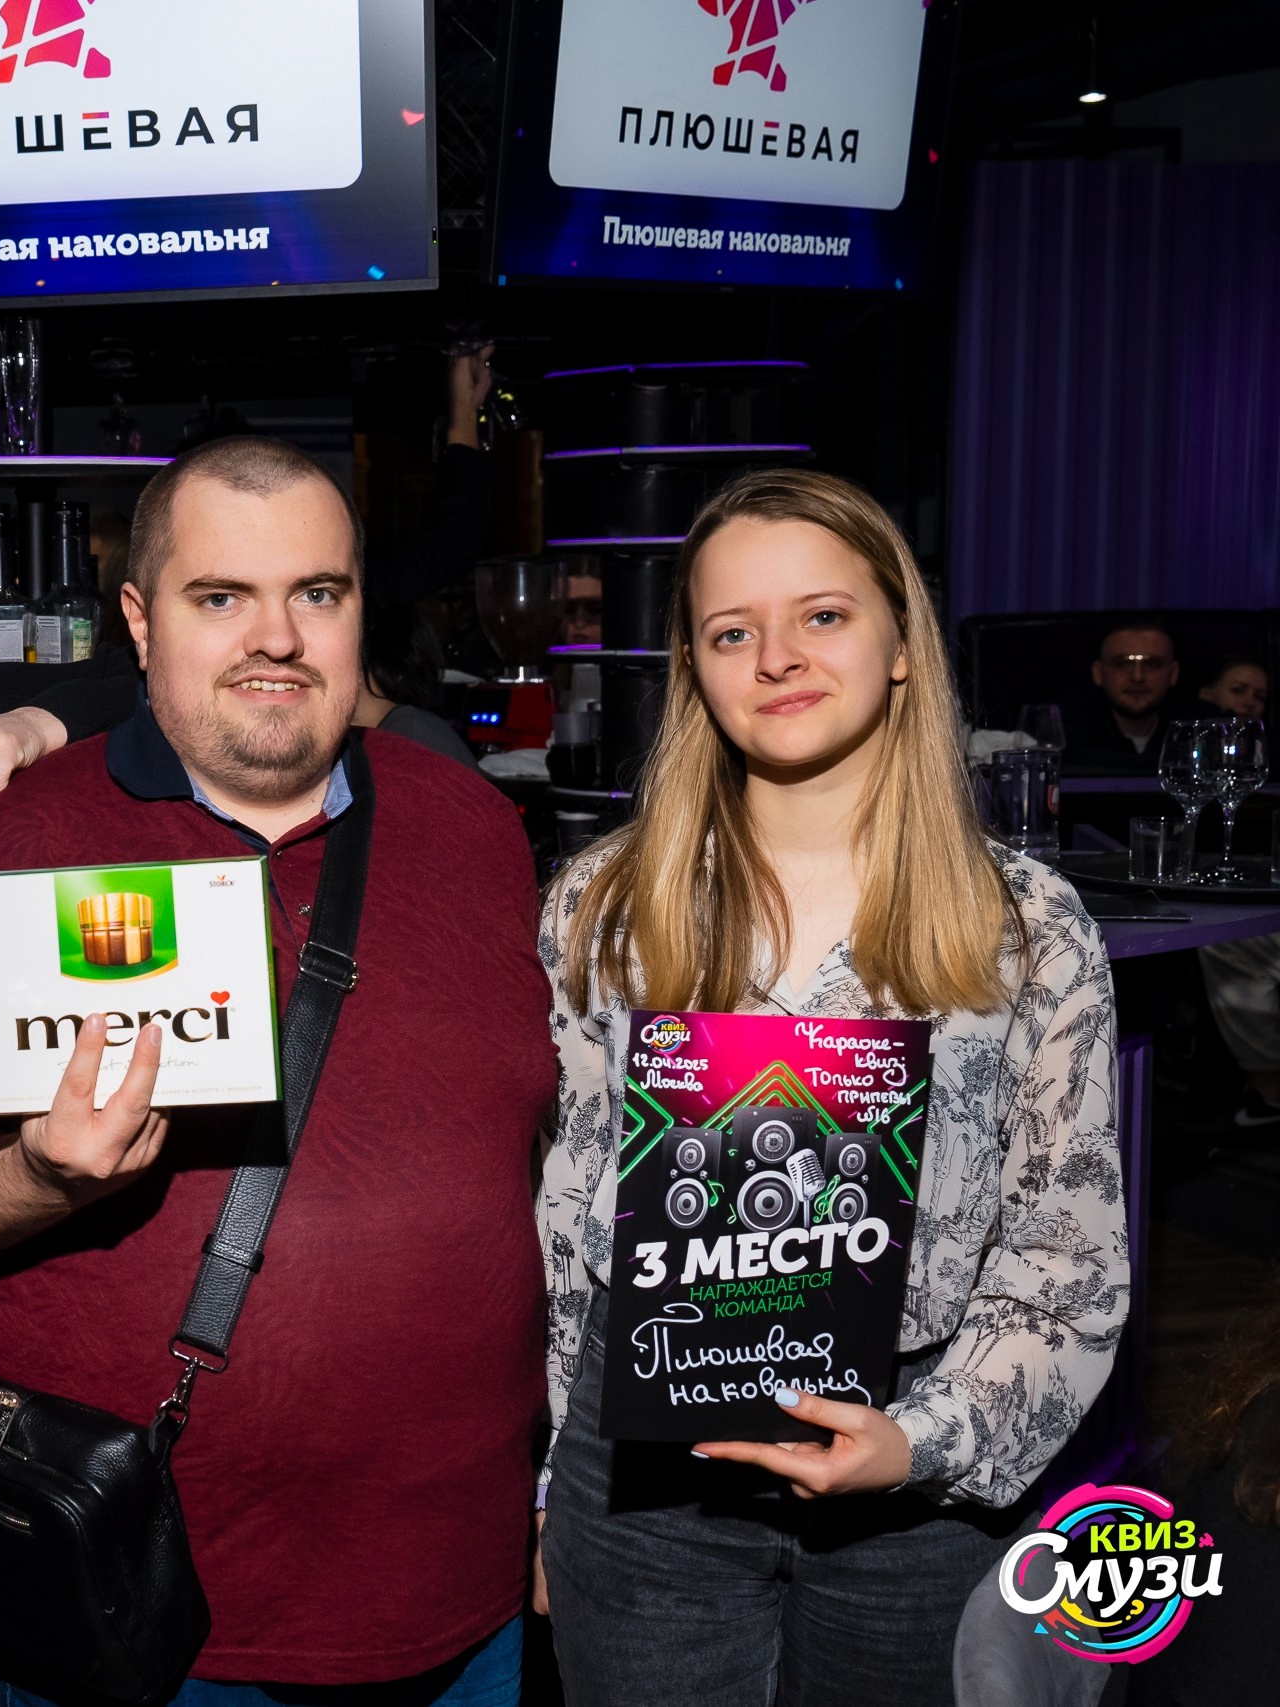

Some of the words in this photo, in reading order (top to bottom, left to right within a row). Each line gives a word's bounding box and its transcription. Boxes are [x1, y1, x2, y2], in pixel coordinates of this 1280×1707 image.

[619, 106, 859, 163] ПЛЮШЕВАЯ
[49, 227, 270, 259] наковальня
[603, 216, 723, 250] Плюшевая
[728, 230, 851, 257] наковальня
[15, 991, 231, 1051] merci
[640, 1024, 691, 1045] Смузи
[661, 1023, 686, 1031] КВИЗ
[632, 1052, 709, 1071] 12.04.2025
[803, 1067, 875, 1087] Только
[640, 1069, 704, 1092] Москва
[632, 1241, 668, 1289] 3
[680, 1217, 890, 1285] МЕСТО
[690, 1271, 833, 1302] НАГРАЖДАЕТСЯ
[715, 1293, 806, 1318] КОМАНДА
[631, 1303, 834, 1379] Плюшевая
